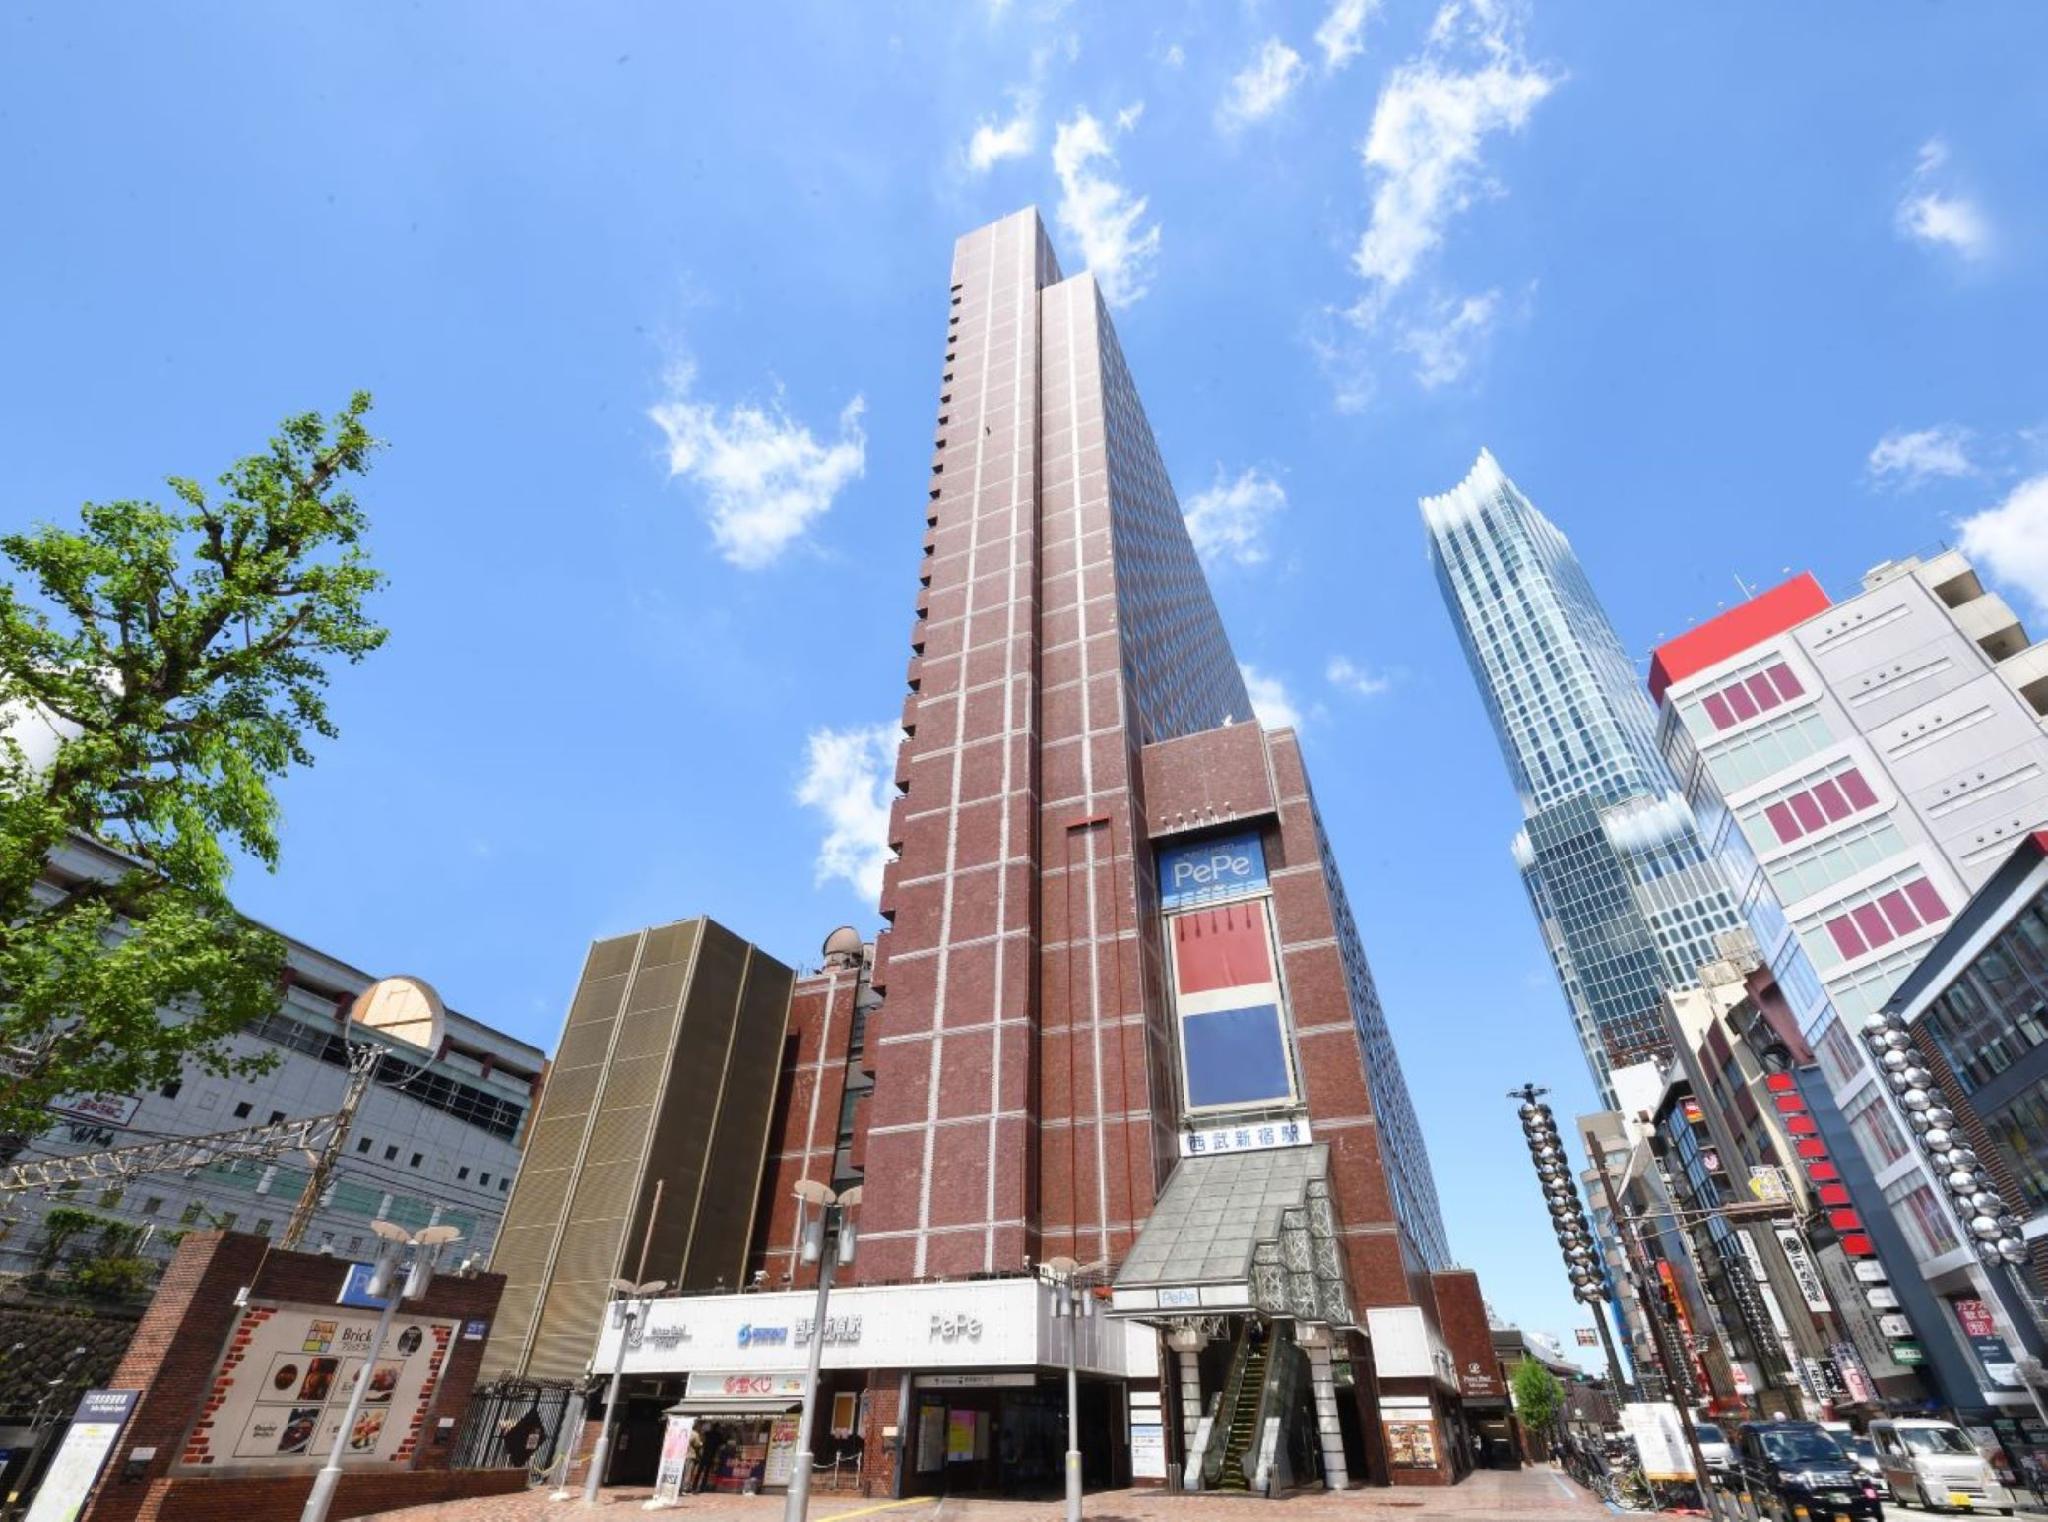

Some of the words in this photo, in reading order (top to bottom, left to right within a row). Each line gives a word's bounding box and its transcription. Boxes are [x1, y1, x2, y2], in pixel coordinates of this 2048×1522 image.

[1174, 855, 1250, 888] PePe
[1187, 1124, 1300, 1152] 西武新宿駅
[929, 1314, 982, 1342] PePe
